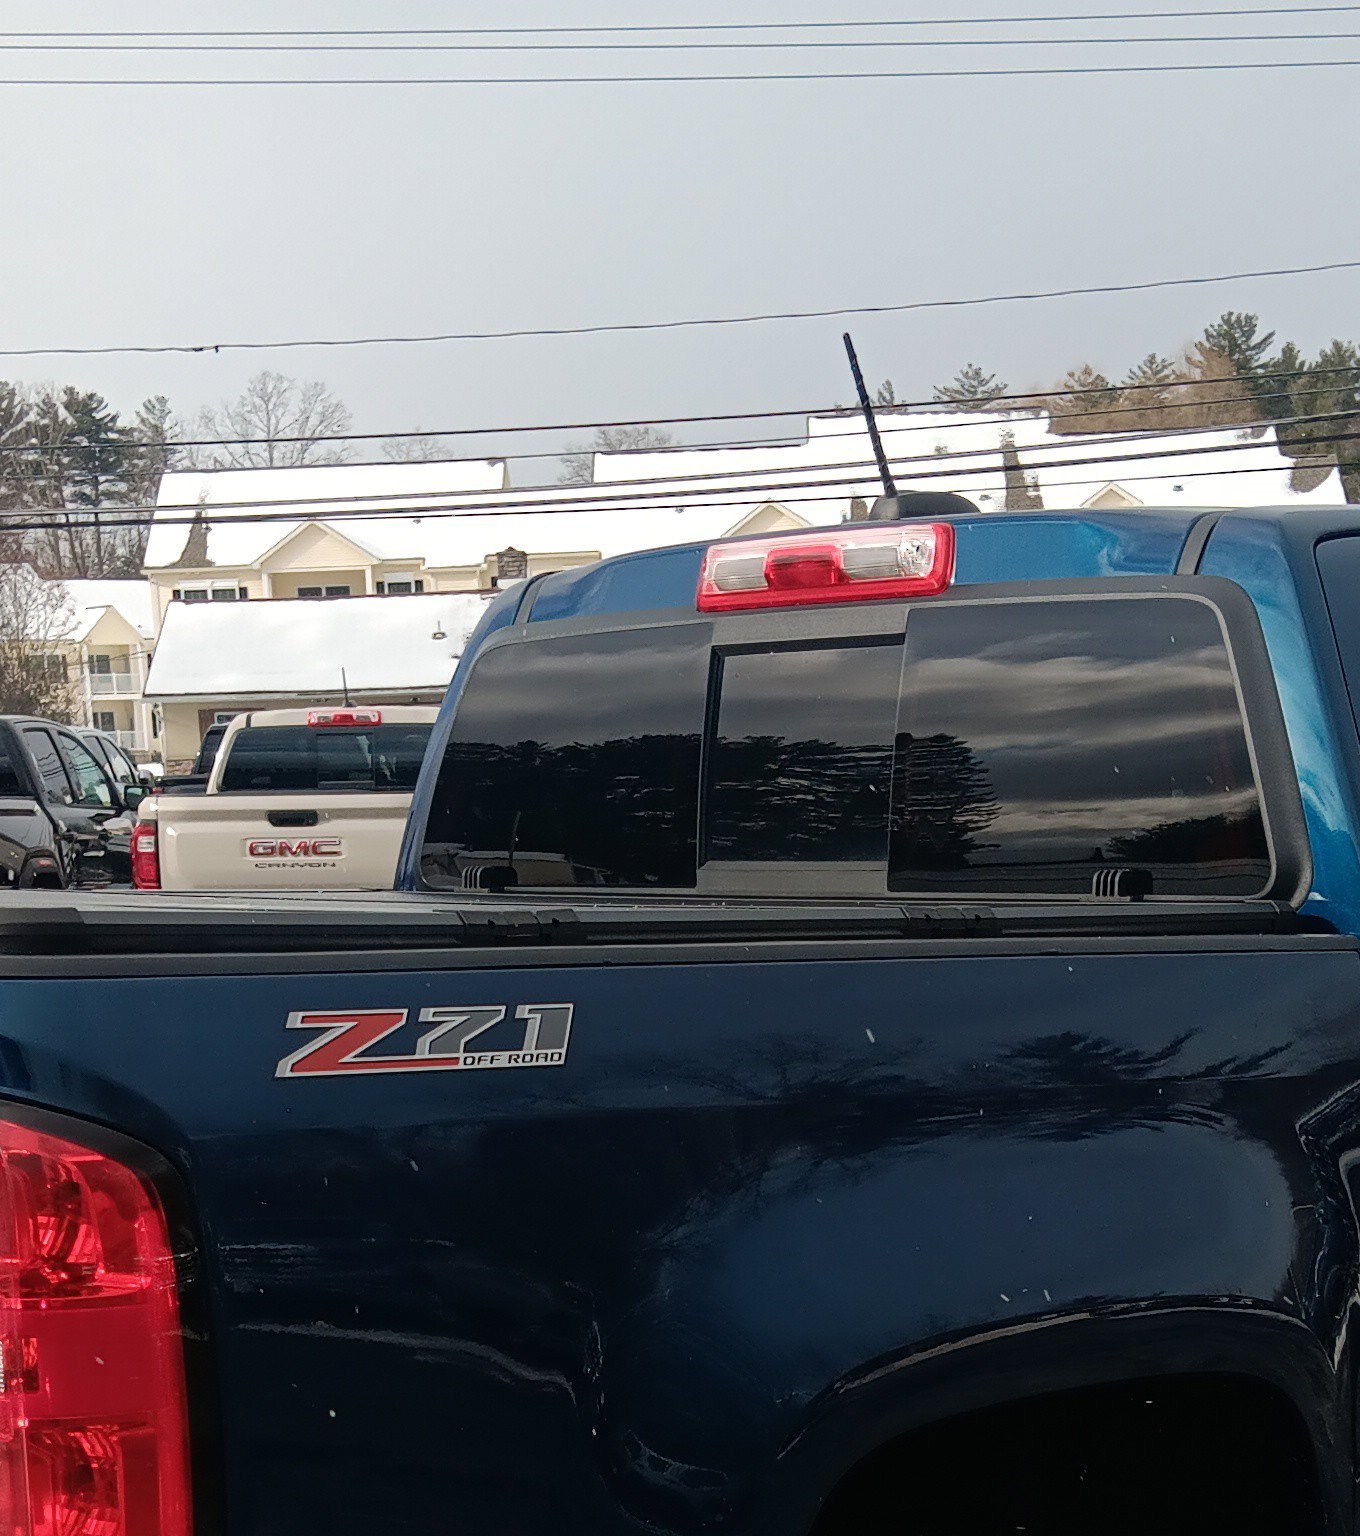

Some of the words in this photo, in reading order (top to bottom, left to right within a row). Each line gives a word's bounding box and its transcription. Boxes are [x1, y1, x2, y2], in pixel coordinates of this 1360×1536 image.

[247, 840, 342, 857] GMC
[274, 1002, 574, 1078] Z71
[462, 1054, 503, 1067] OFF
[507, 1051, 563, 1065] ROAD
